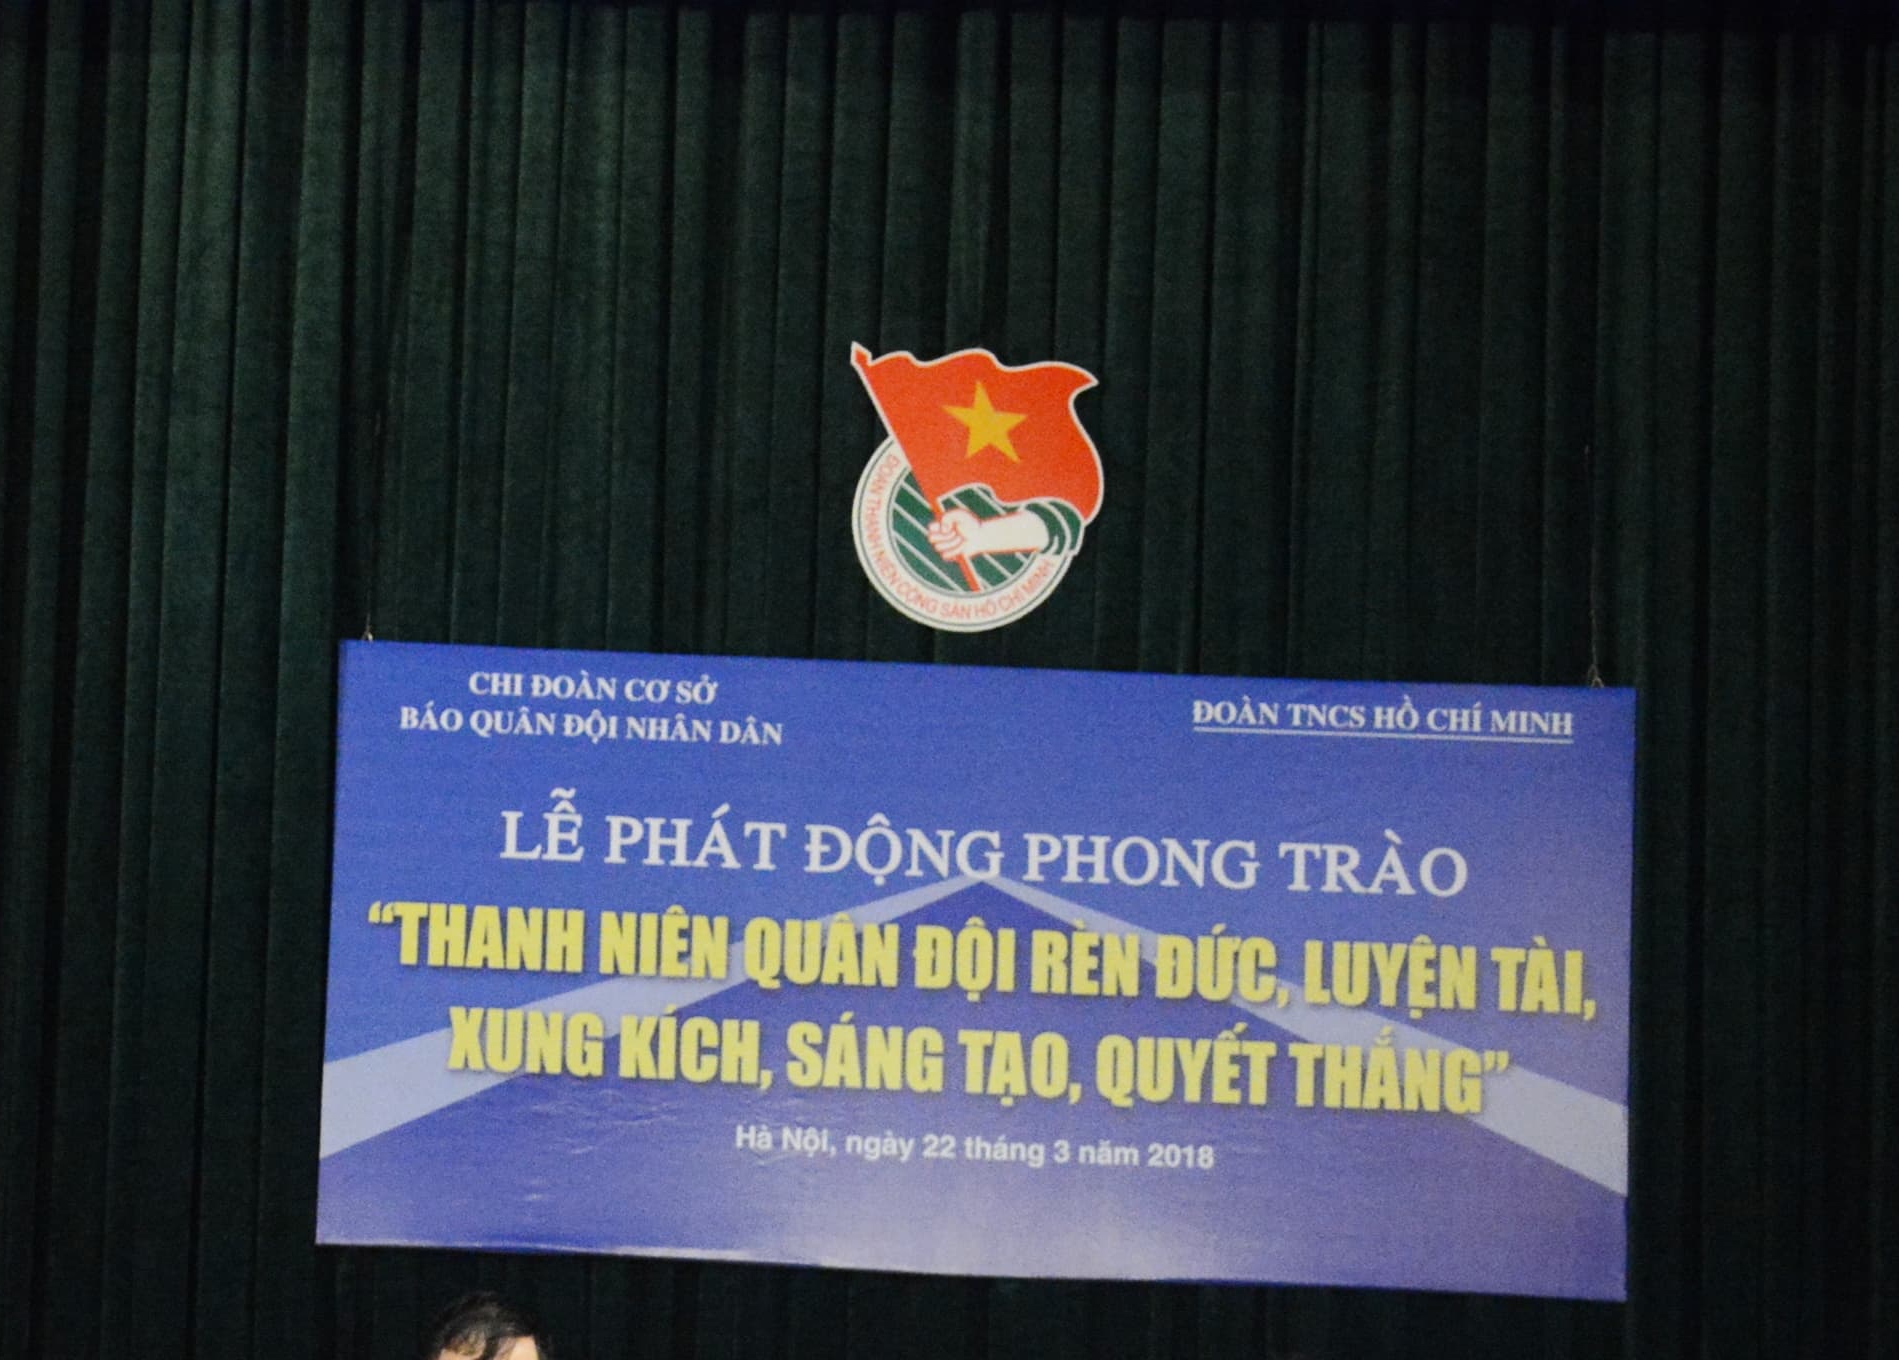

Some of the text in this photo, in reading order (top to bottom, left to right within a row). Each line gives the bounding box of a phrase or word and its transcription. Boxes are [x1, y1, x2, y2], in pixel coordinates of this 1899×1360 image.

[469, 669, 718, 705] CHI ĐOÀN CƠ SỞ
[400, 701, 784, 747] BÁO QUÂN ĐỘI NHÂN DÂN
[1193, 695, 1574, 737] ĐOÀN TNCS HỒ CHÍ MINH
[500, 787, 1468, 898] LỄ PHÁT ĐỘNG PHONG TRÀO
[599, 904, 729, 980] NIÊN
[744, 914, 900, 991] QUÂN
[912, 917, 1016, 1002] ĐỘI
[1031, 918, 1139, 997] RÈN
[1155, 923, 1290, 1009] ĐỨC,
[1304, 934, 1477, 1019] LUYỆN
[1491, 936, 1597, 1020] TÀI,
[447, 1006, 604, 1078] XUNG
[618, 1004, 773, 1090] KÍCH,
[786, 1011, 944, 1094] SÁNG
[958, 1029, 1082, 1106] TẠO,
[1096, 1022, 1276, 1108] QUYẾT
[735, 1125, 1214, 1170] Hà Nội, ngày 22 tháng 3 năm 2018
